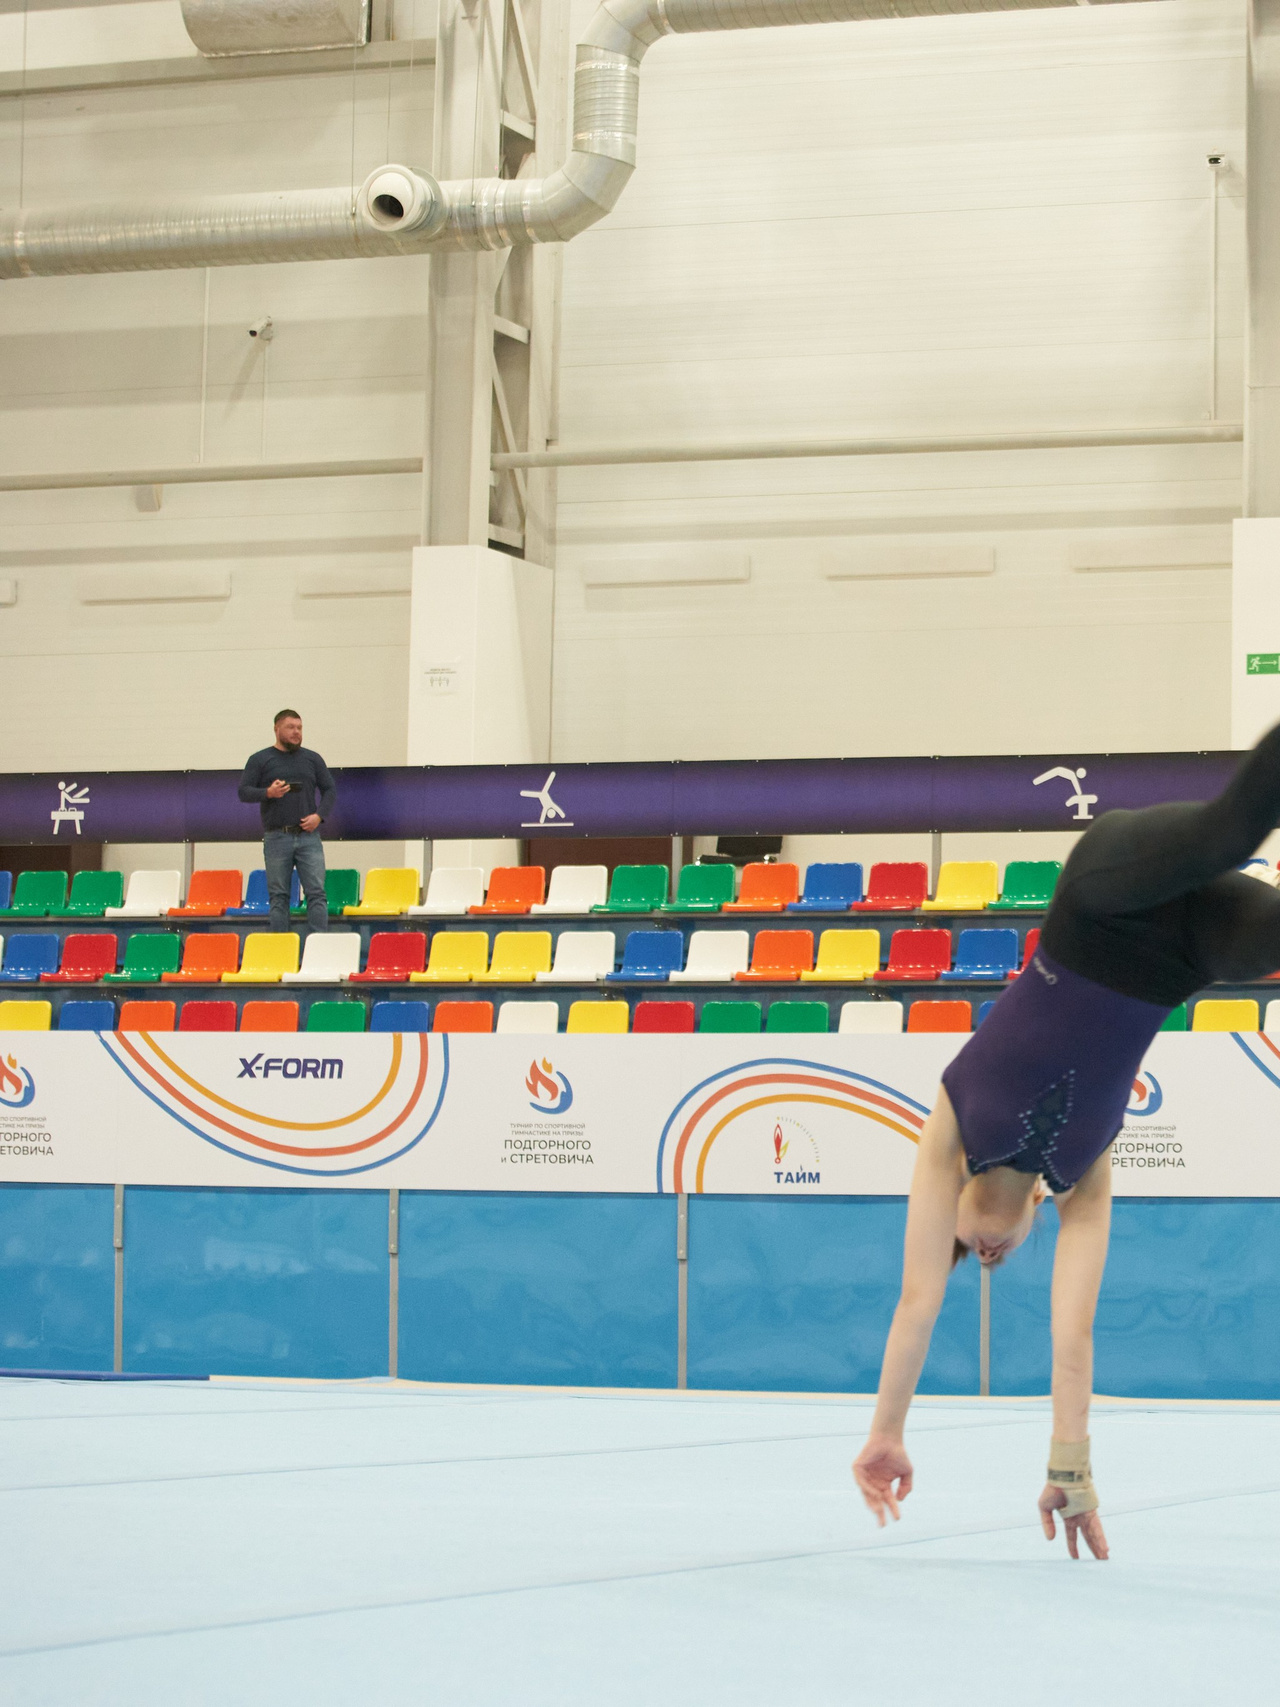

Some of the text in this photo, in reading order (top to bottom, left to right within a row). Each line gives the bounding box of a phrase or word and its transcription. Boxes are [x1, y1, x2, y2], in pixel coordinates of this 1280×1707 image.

[237, 1053, 344, 1079] X-FORM
[0, 1132, 52, 1142] ГОРНОГО
[504, 1139, 592, 1151] ПОДГОРНОГО
[0, 1146, 54, 1156] ЕТОВИЧА
[510, 1153, 594, 1164] СТРЕТОВИЧА
[774, 1164, 820, 1183] ТАЙМ
